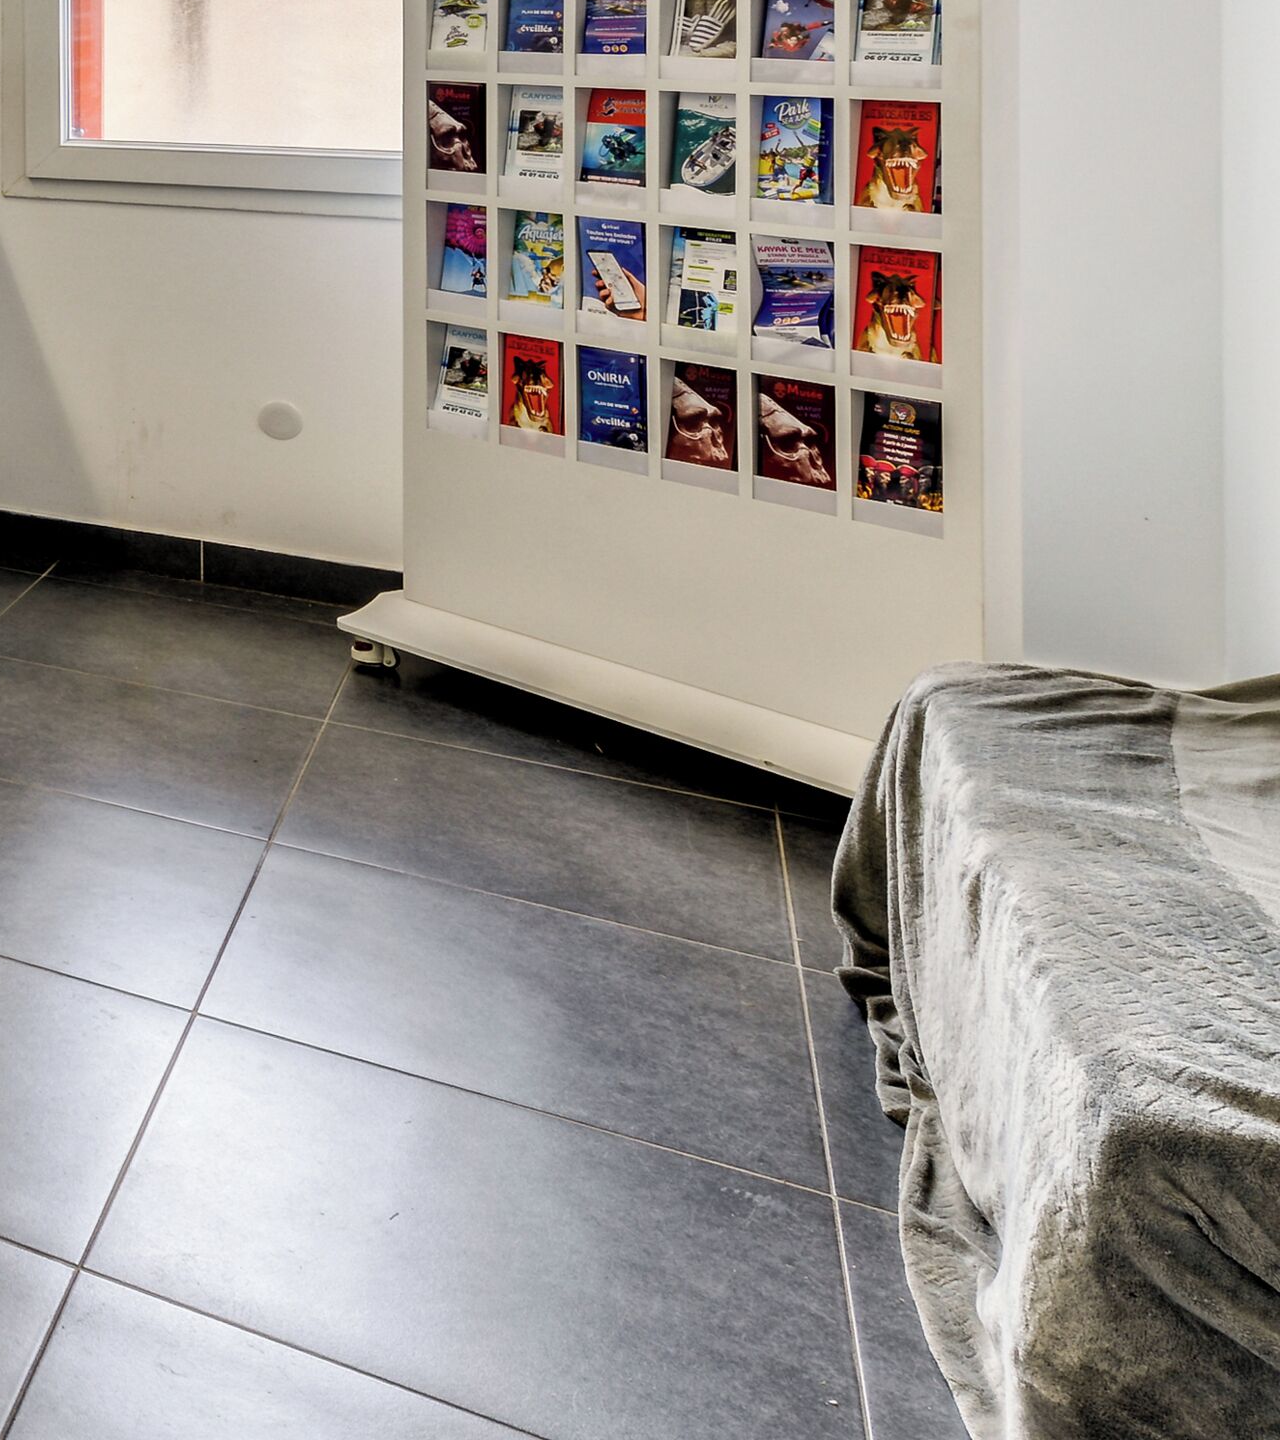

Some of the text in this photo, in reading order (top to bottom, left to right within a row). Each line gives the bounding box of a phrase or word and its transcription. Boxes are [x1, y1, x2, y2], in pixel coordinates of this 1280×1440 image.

[774, 98, 811, 121] Park
[757, 245, 789, 254] KAYAK
[806, 247, 827, 255] MER
[587, 370, 630, 386] ONIRIA
[787, 383, 823, 401] Musée
